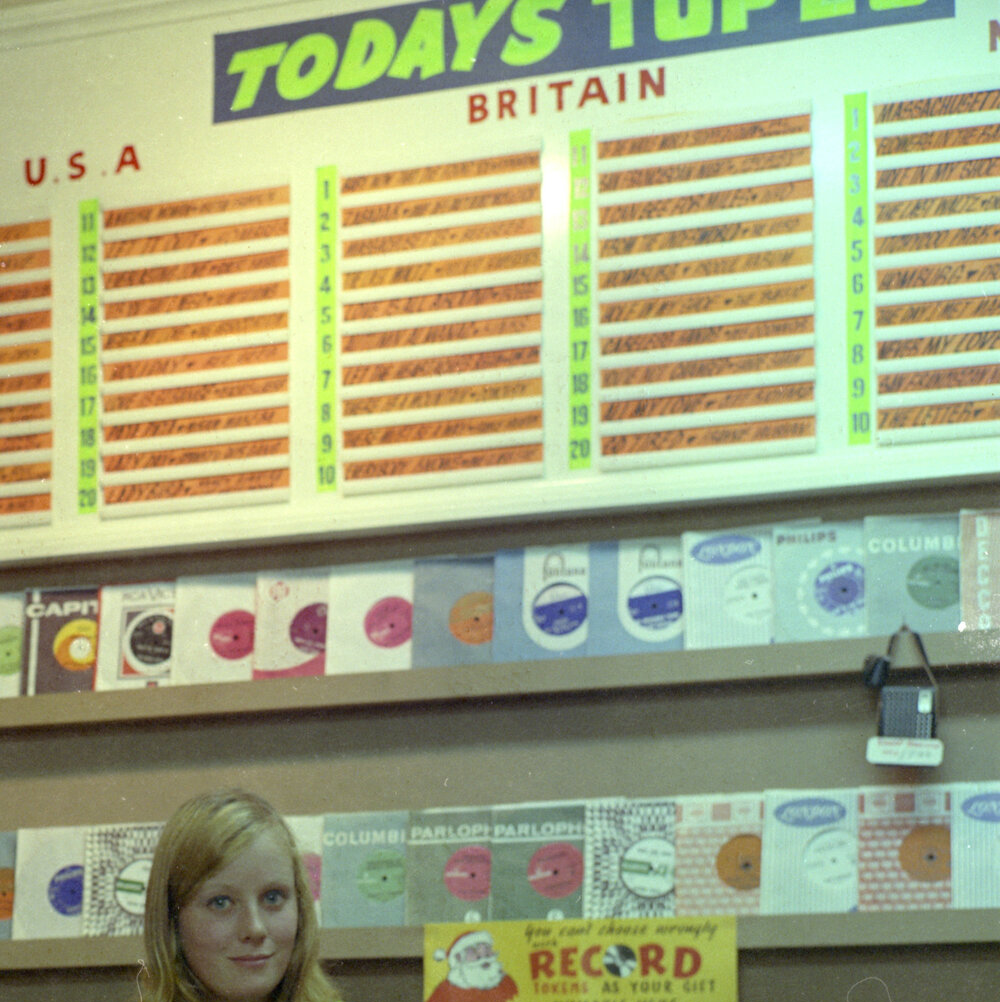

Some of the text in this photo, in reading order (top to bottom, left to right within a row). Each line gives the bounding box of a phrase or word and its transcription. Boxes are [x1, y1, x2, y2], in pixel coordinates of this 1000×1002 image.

[227, 0, 566, 112] TODAYS
[467, 67, 666, 124] BRITAIN
[572, 274, 589, 296] 15
[80, 307, 97, 325] 14
[572, 307, 589, 328] 16
[80, 336, 97, 355] 15
[572, 340, 589, 360] 17
[80, 366, 97, 385] 16
[572, 373, 589, 394] 18
[80, 396, 97, 414] 17
[571, 405, 589, 426] 19
[852, 411, 870, 433] 10
[80, 428, 97, 447] 18
[571, 439, 590, 459] 20
[80, 459, 97, 477] 19
[319, 465, 335, 486] 10
[776, 530, 837, 546] PHILIPS
[654, 920, 719, 943] wrongly
[529, 943, 703, 981] RECORD
[602, 980, 620, 994] AS
[630, 979, 674, 994] YOUR
[682, 978, 716, 994] GIFT
